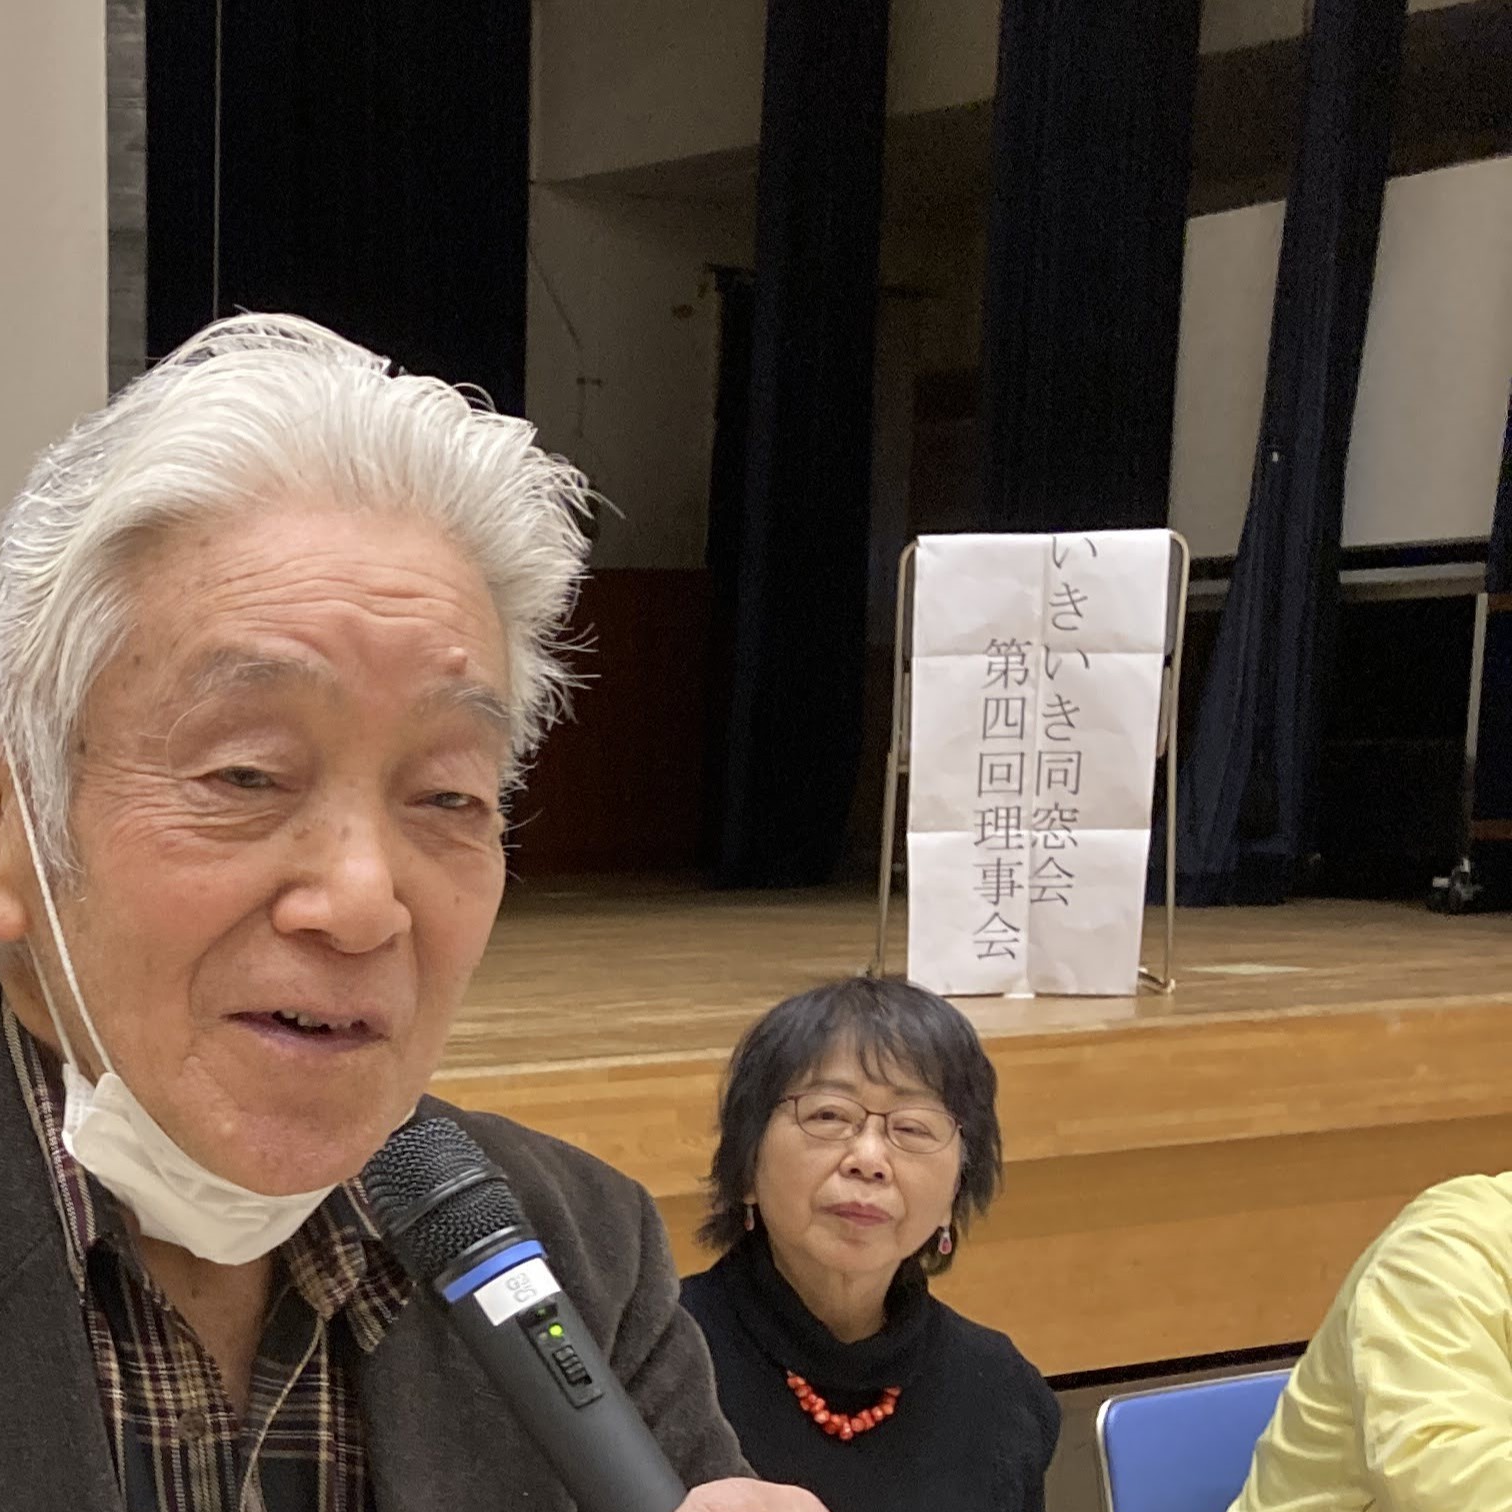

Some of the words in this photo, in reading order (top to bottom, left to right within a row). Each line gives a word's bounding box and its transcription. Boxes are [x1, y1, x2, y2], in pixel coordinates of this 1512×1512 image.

[973, 637, 1033, 960] 第四回理事会
[1029, 535, 1097, 906] いきいき同窓会
